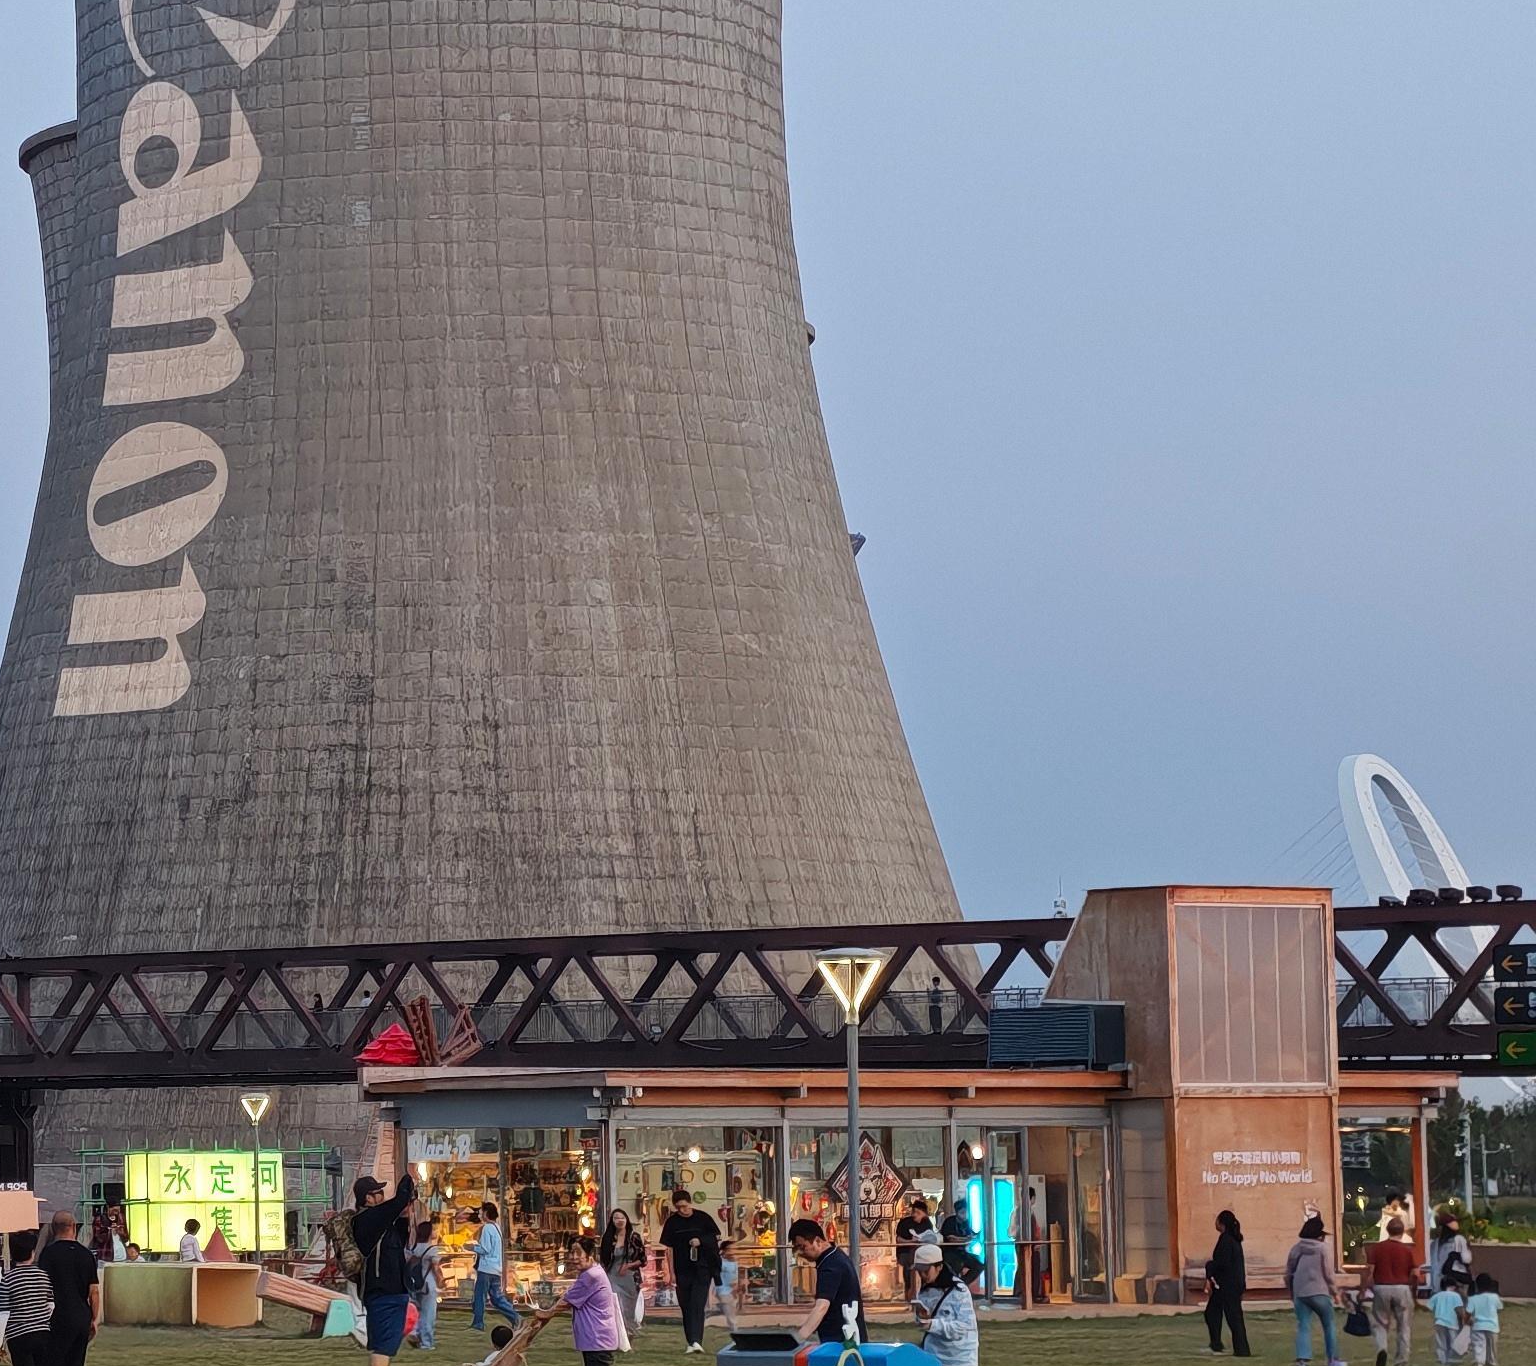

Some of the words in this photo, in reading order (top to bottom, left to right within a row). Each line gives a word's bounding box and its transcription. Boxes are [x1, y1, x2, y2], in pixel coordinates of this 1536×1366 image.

[164, 1160, 278, 1194] 永定河
[1278, 1169, 1313, 1184] World
